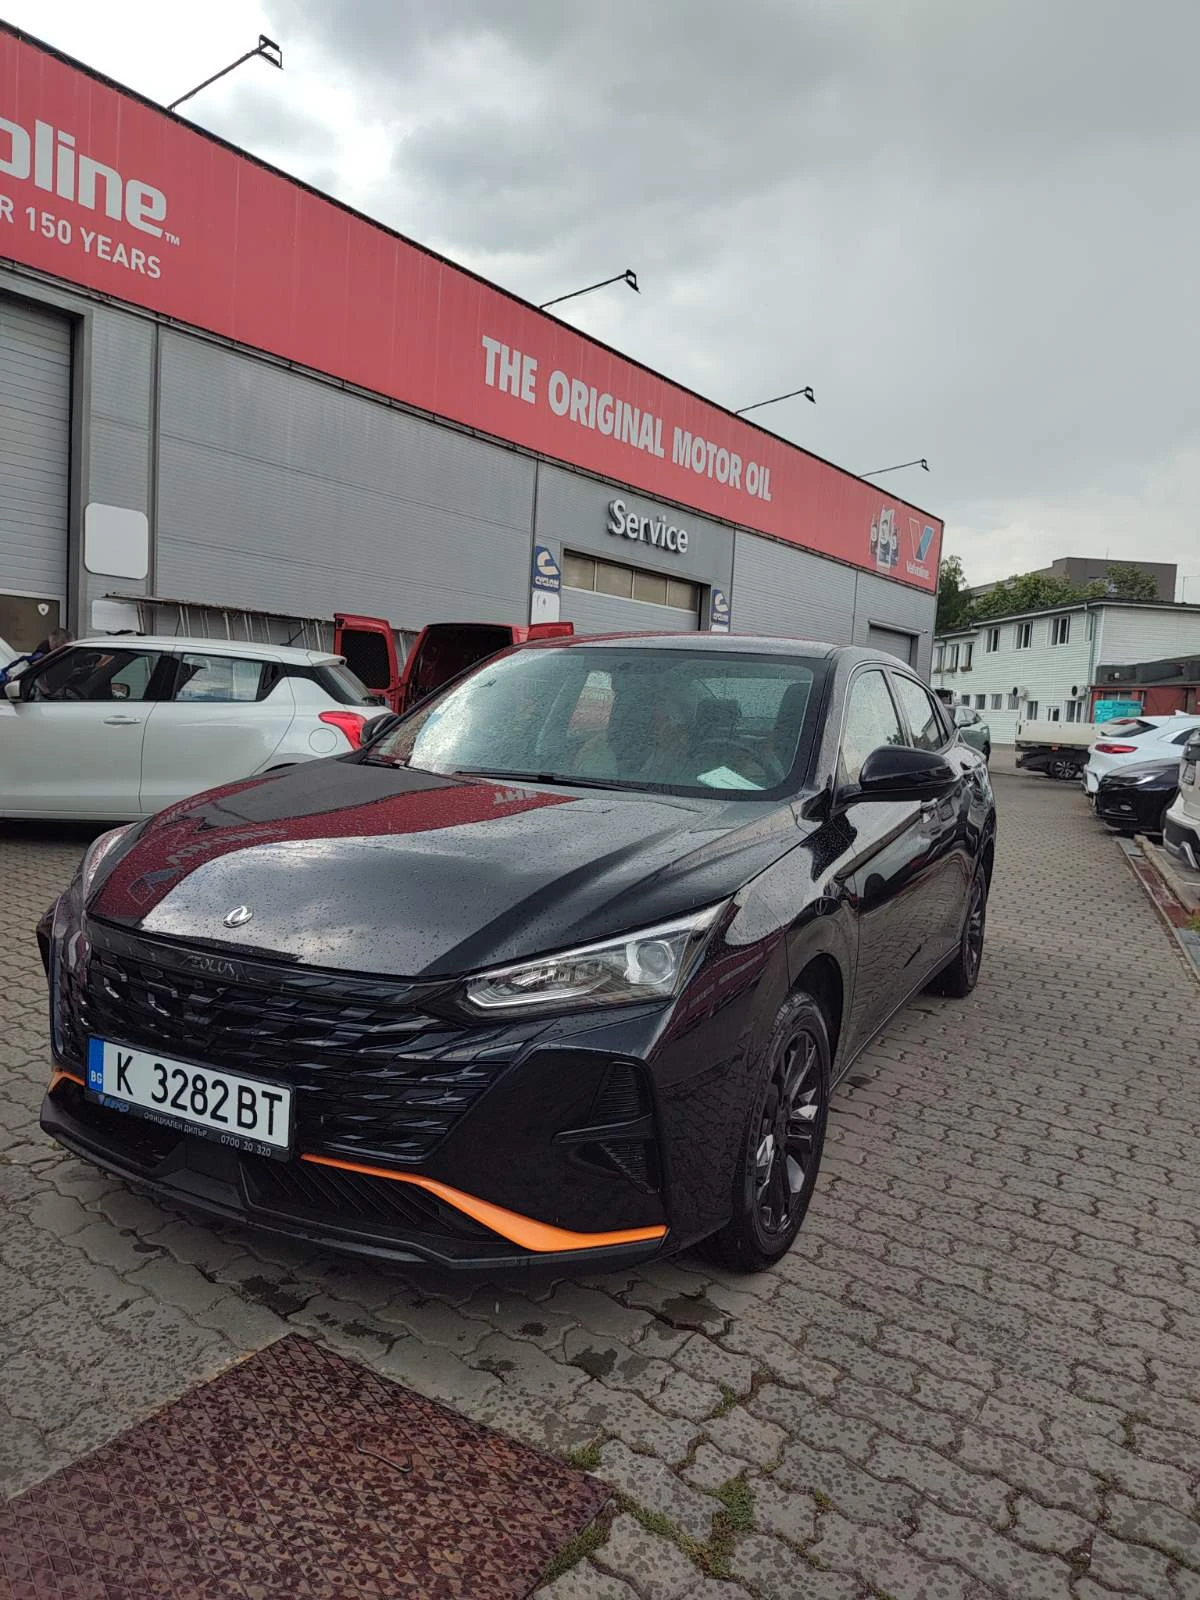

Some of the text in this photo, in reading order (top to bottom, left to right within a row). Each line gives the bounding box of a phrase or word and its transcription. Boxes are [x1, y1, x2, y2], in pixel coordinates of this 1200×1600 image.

[25, 206, 72, 245] 150
[80, 226, 161, 279] YEARS
[482, 334, 772, 501] THE ORIGINAL MOTOR OIL
[606, 498, 689, 553] Service
[90, 1070, 103, 1084] BG
[117, 1052, 283, 1136] K 3282BT
[220, 1134, 272, 1157] 0700 20 320
